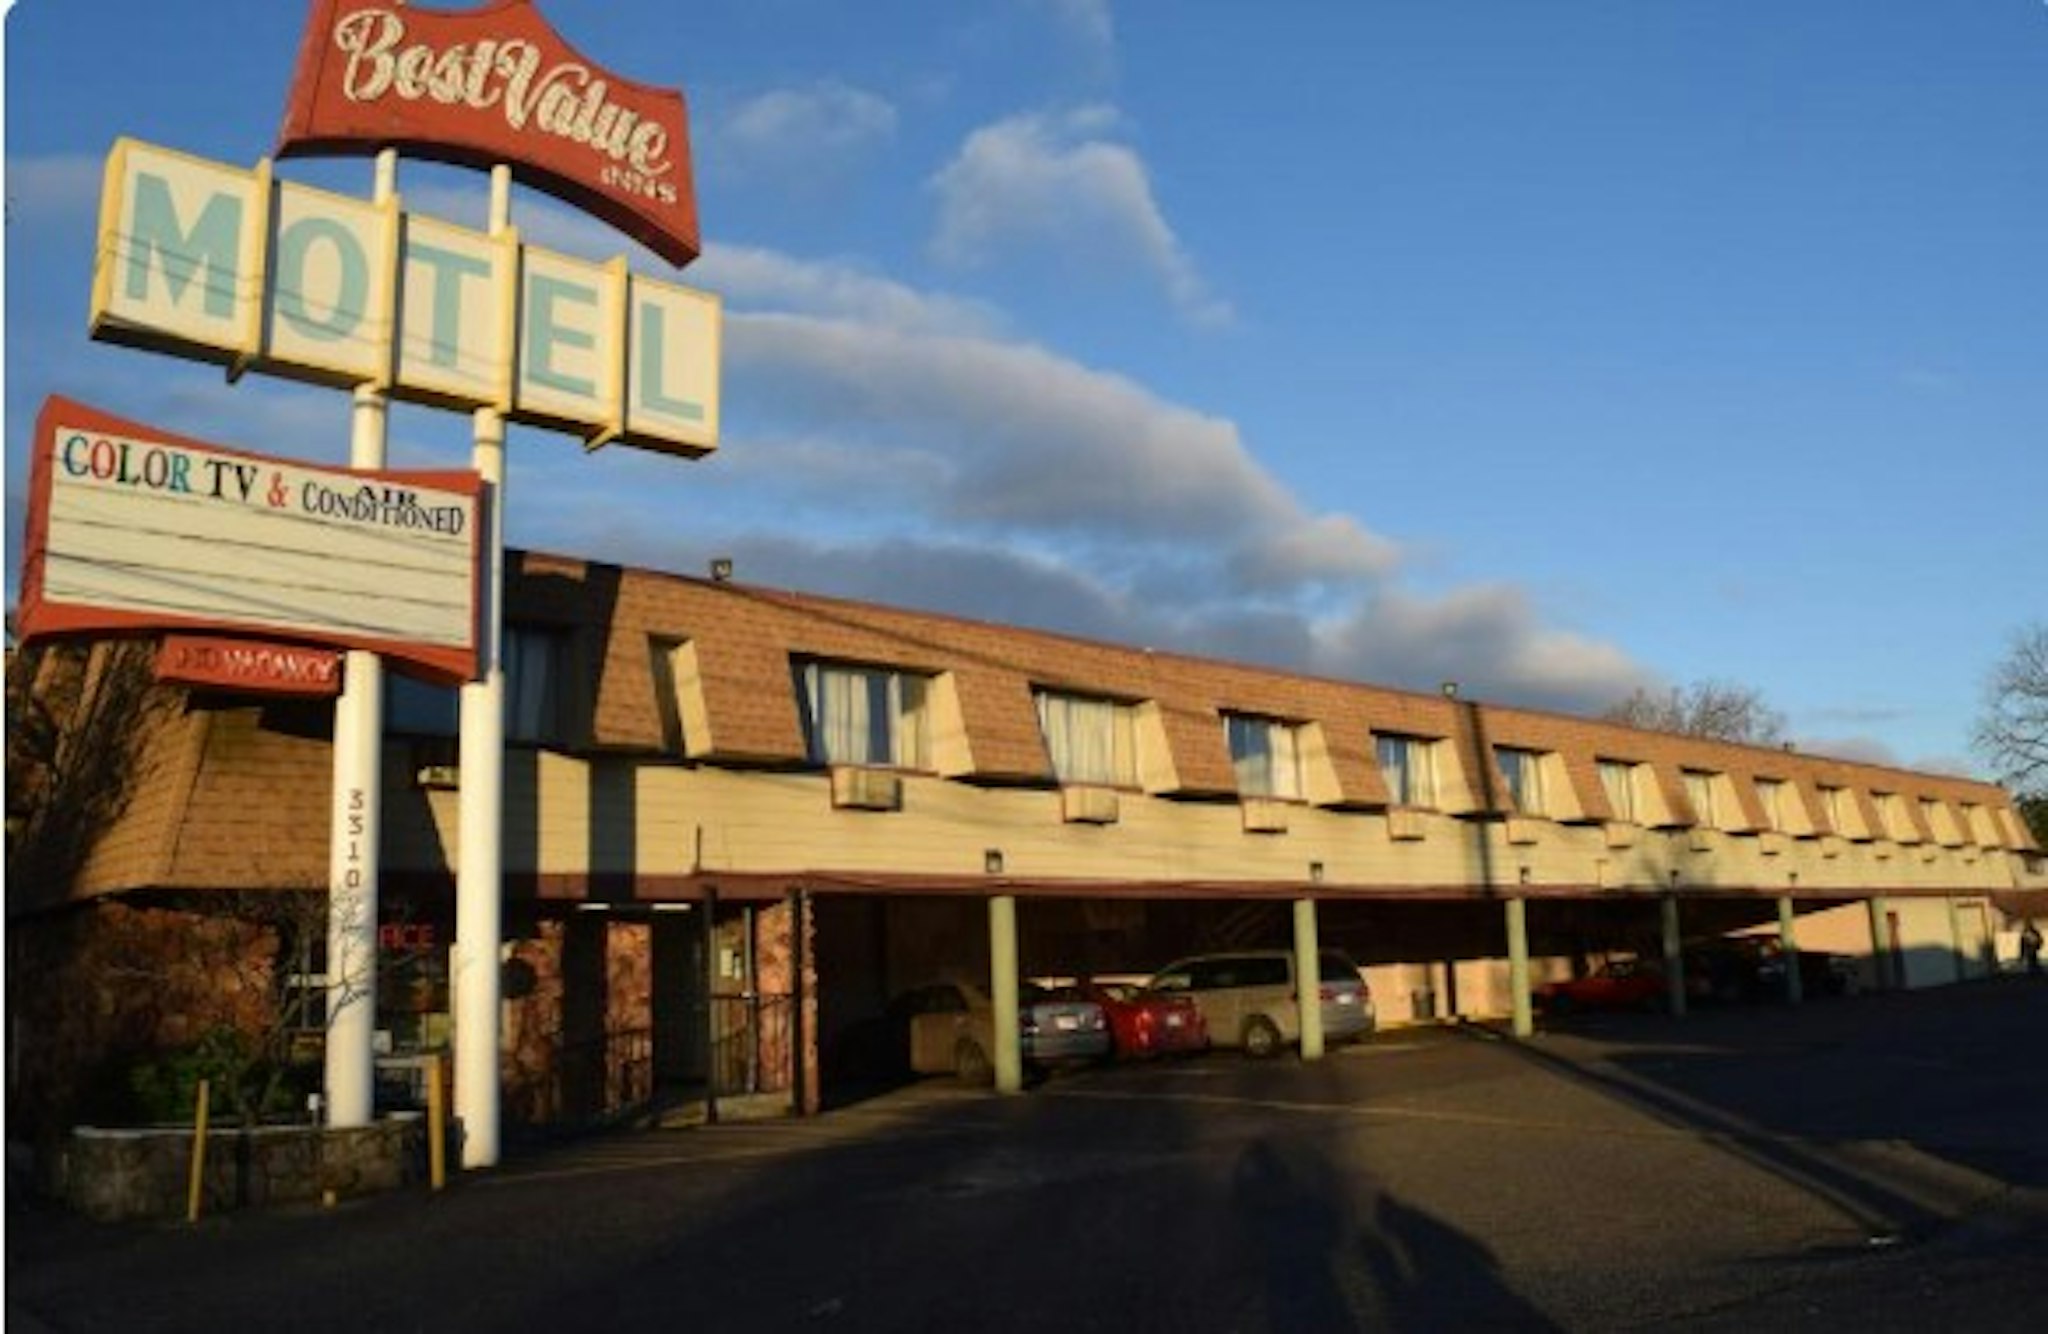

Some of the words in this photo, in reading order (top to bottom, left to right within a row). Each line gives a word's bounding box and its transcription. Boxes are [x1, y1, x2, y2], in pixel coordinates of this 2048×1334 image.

[334, 9, 501, 108] Best
[500, 39, 673, 176] Value
[122, 171, 705, 421] MOTEL
[63, 434, 193, 494] COLOR
[204, 458, 258, 503] TV
[266, 470, 289, 508] &
[224, 648, 334, 683] VACANCY
